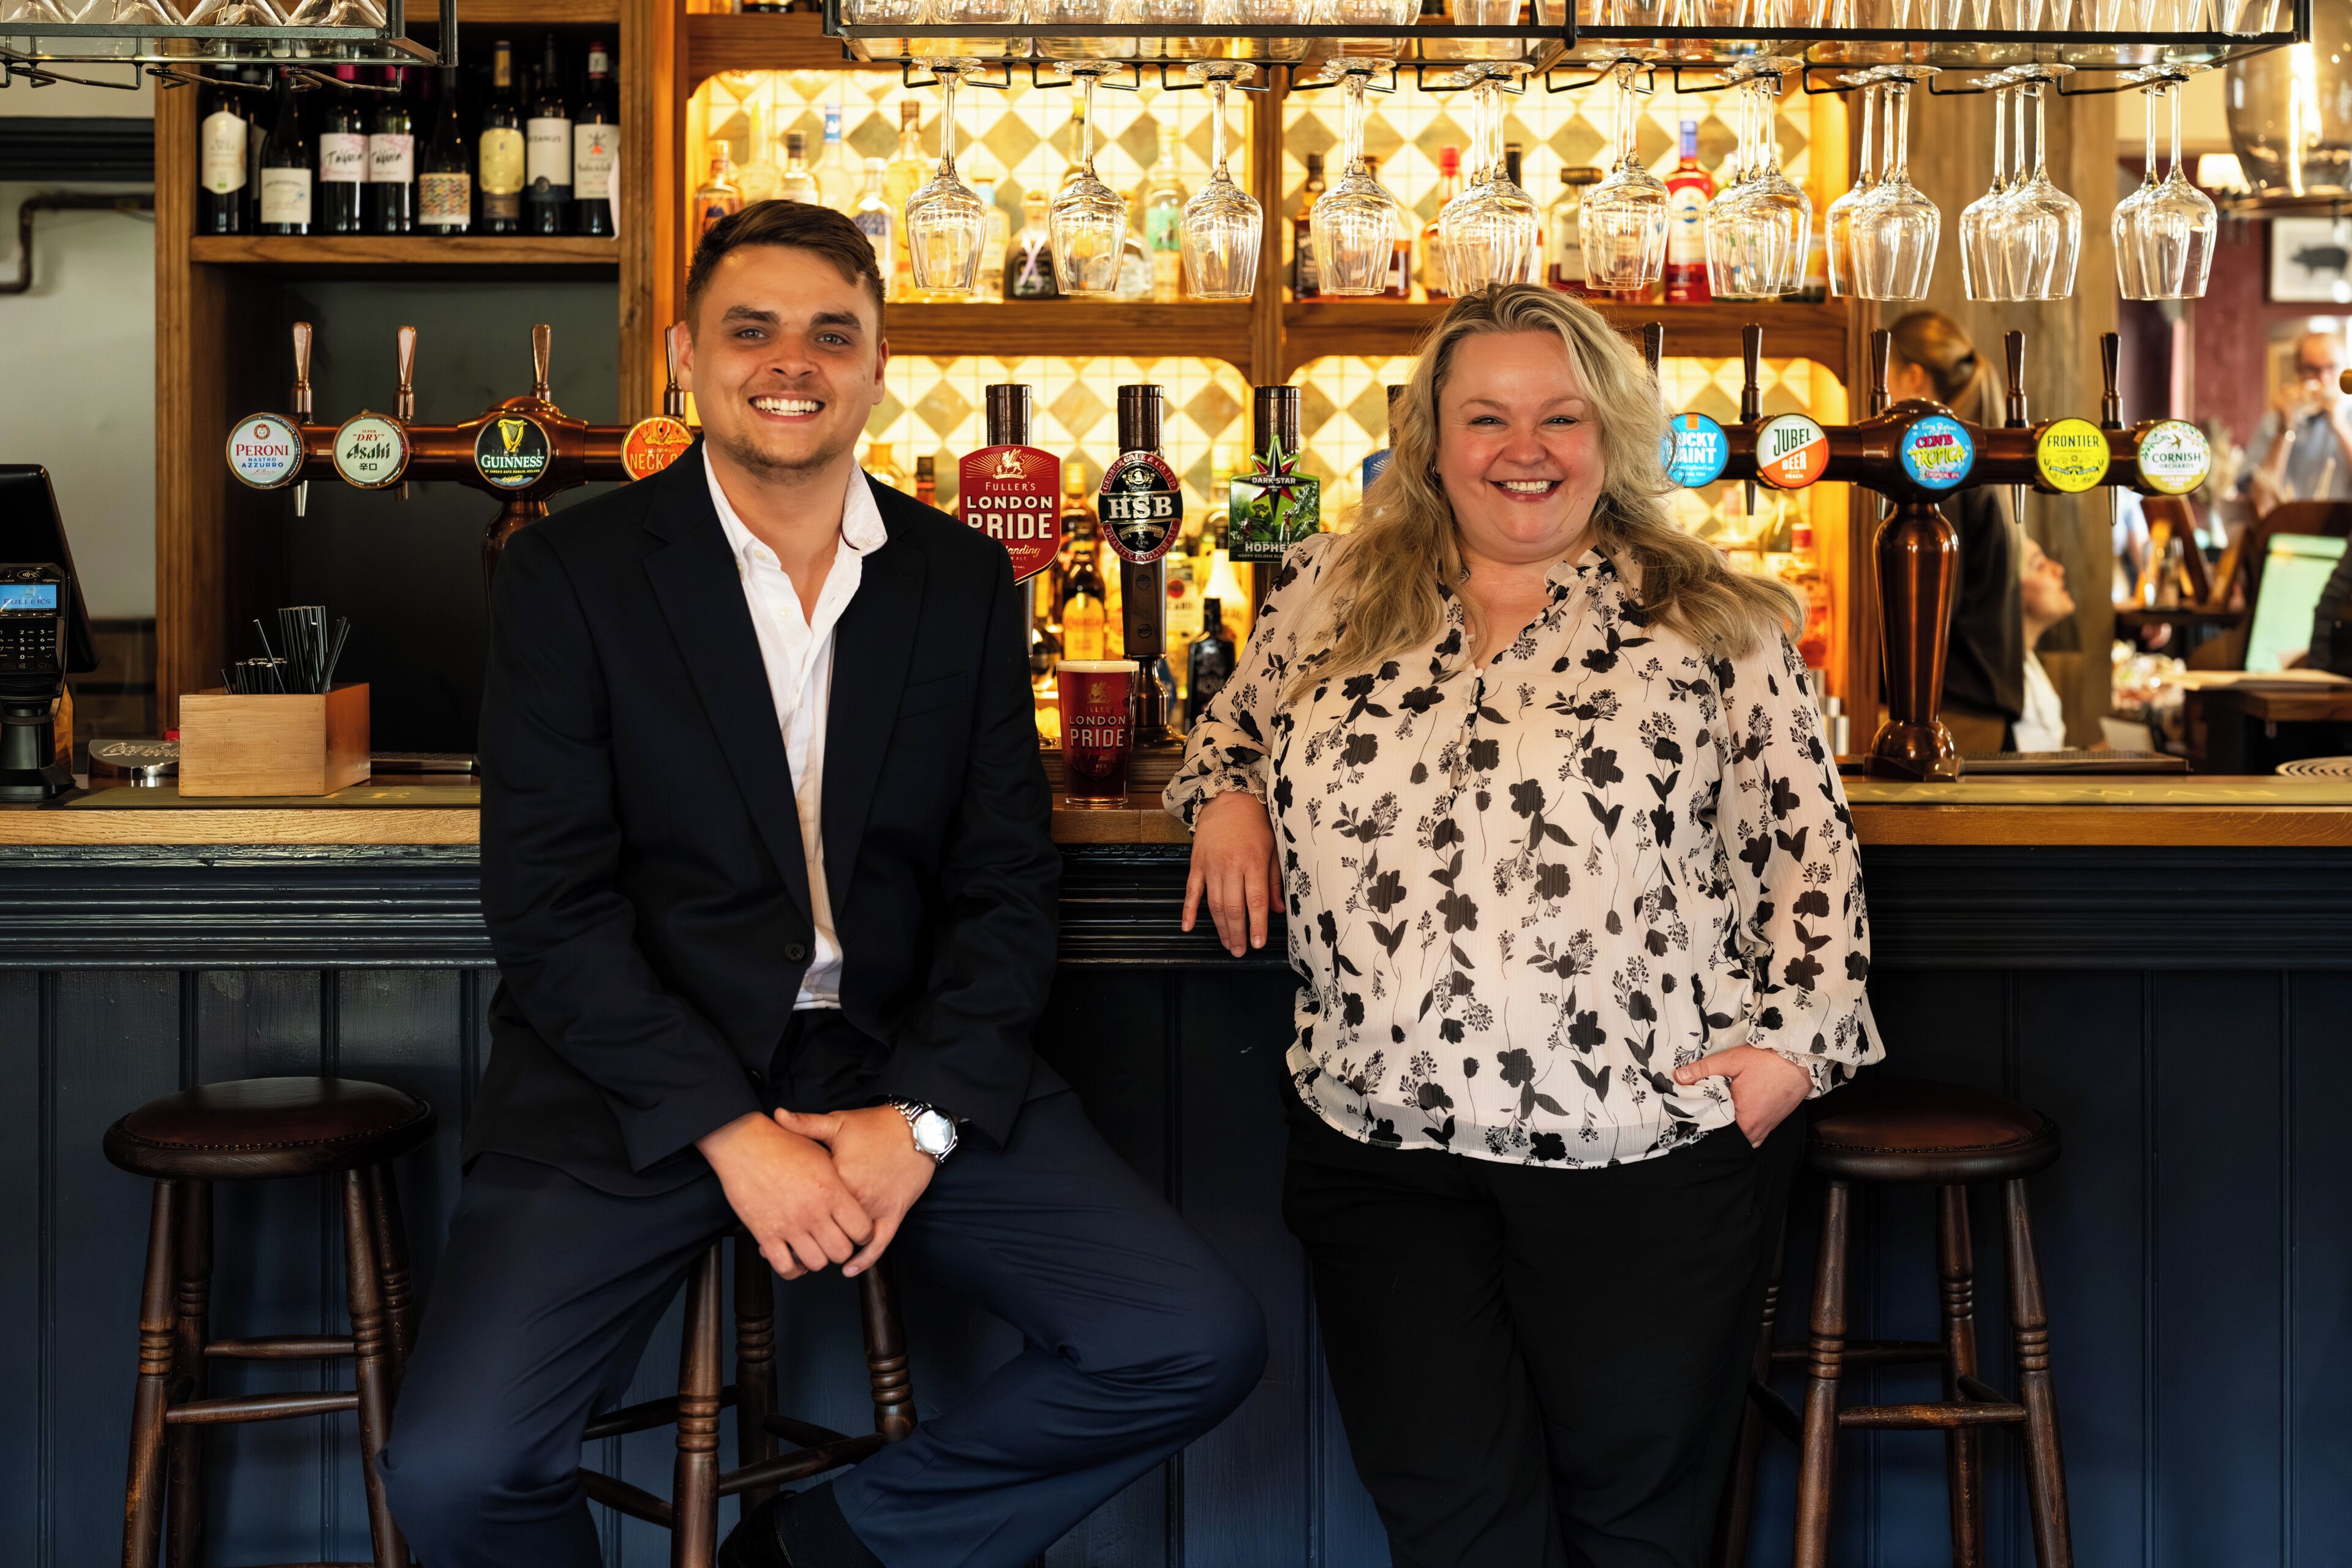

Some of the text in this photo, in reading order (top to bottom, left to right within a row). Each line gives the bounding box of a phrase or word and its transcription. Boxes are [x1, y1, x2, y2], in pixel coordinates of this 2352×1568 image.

[1676, 432, 1717, 447] UCKY
[1774, 429, 1811, 456] JUBEL
[1916, 434, 1953, 448] CLWB
[2048, 435, 2099, 447] FRONTIER
[236, 444, 288, 456] PERONI
[346, 442, 390, 459] Asahi
[1675, 447, 1717, 464] AINT
[1909, 445, 1964, 469] TROPICA
[2152, 452, 2201, 462] CORNISH
[359, 462, 377, 471] 辛口
[481, 454, 543, 468] GUINNESS
[630, 453, 665, 470] NECK
[1782, 450, 1806, 470] BEER
[986, 481, 1036, 491] FULLER'S
[1166, 471, 1177, 487] LTD
[967, 496, 1053, 509] LONDON
[1108, 496, 1173, 519] HSB
[967, 513, 1053, 540] PRIDE
[1135, 542, 1169, 561] ENGLISH
[1169, 526, 1178, 541] ALE
[1245, 543, 1287, 552] HOPHE
[1006, 545, 1041, 558] anding
[1069, 715, 1126, 725] LONDON
[1070, 729, 1125, 747] PRIDE
